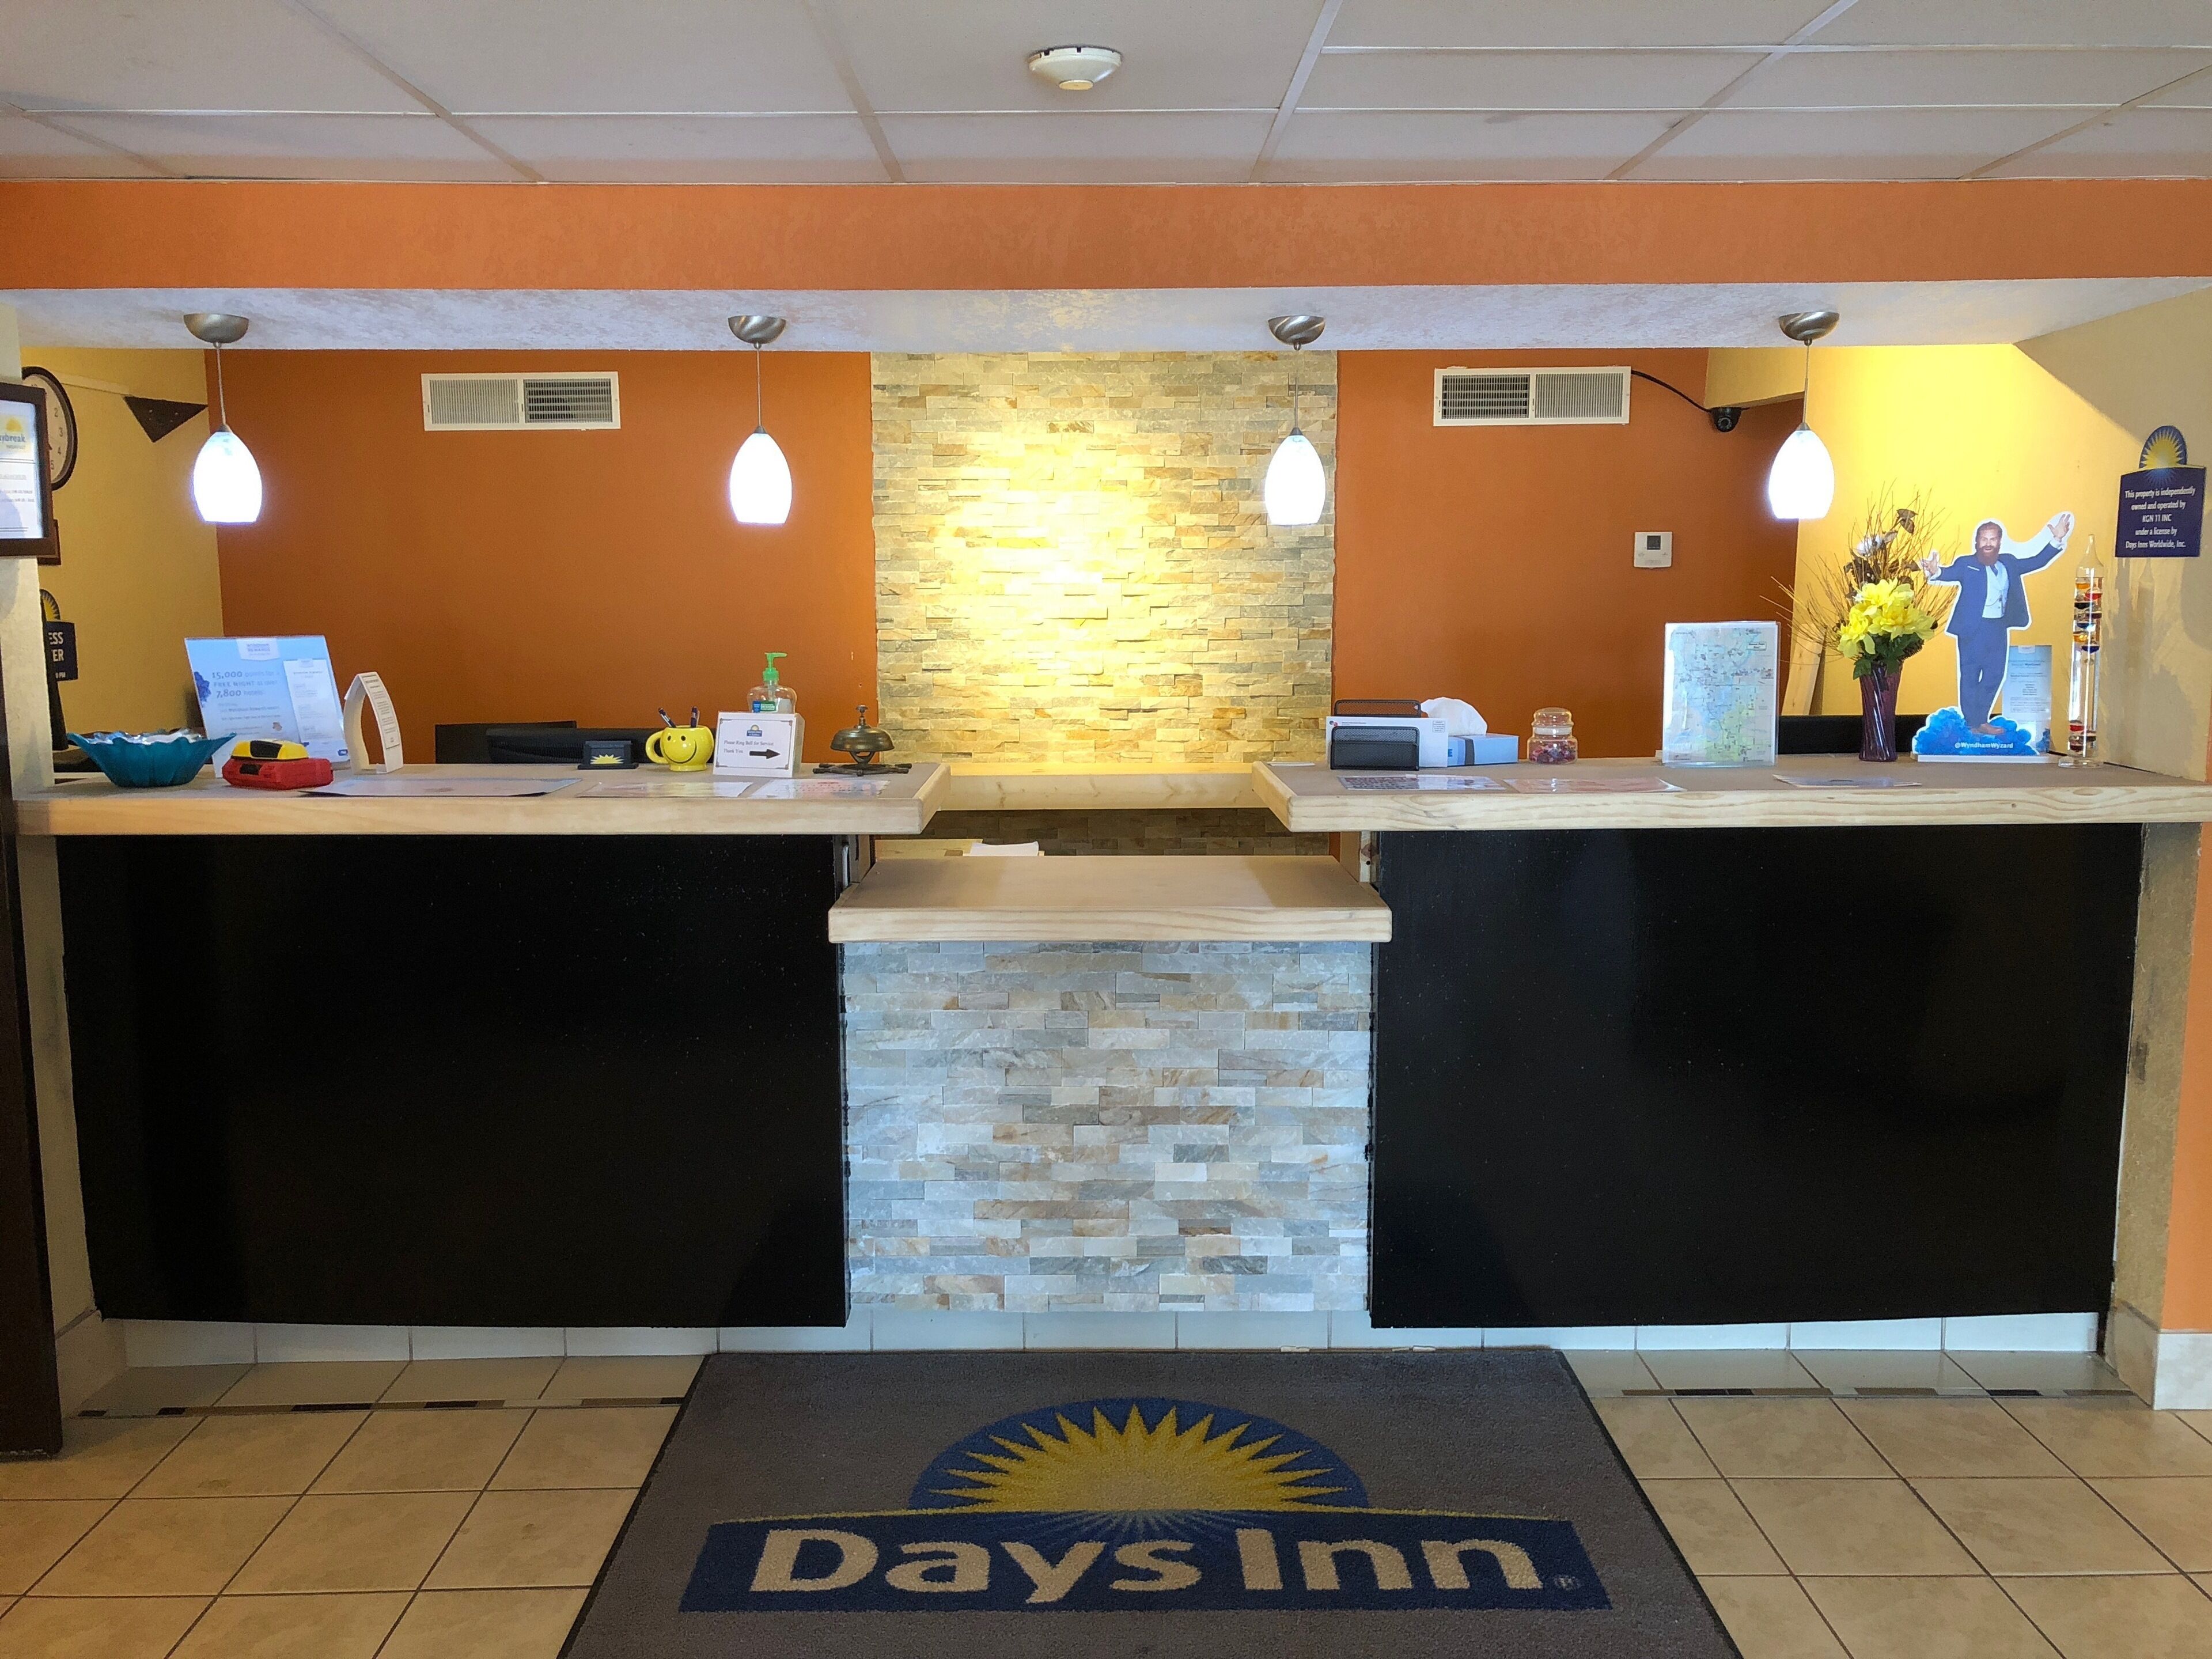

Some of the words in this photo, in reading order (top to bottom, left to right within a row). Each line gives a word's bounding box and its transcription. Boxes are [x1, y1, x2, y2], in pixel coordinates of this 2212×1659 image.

[54, 408, 58, 417] 2
[59, 428, 63, 437] 3
[50, 460, 55, 470] 5
[2125, 490, 2135, 498] This
[2135, 490, 2154, 499] property
[2155, 488, 2160, 496] is
[2160, 486, 2195, 497] independently
[2131, 502, 2147, 510] owned
[2147, 501, 2157, 509] and
[2157, 500, 2179, 510] operated
[2179, 499, 2186, 510] by
[2142, 514, 2154, 522] KGN
[2135, 527, 2149, 535] under
[2153, 527, 2171, 535] license
[2171, 526, 2177, 536] by
[2126, 541, 2137, 550] Days
[2149, 540, 2175, 549] Worldwide,
[51, 649, 65, 662] ER
[212, 671, 243, 680] 15,000
[217, 689, 241, 699] 7,800
[749, 1528, 1203, 1604] Days
[1238, 1528, 1541, 1592] Inn
